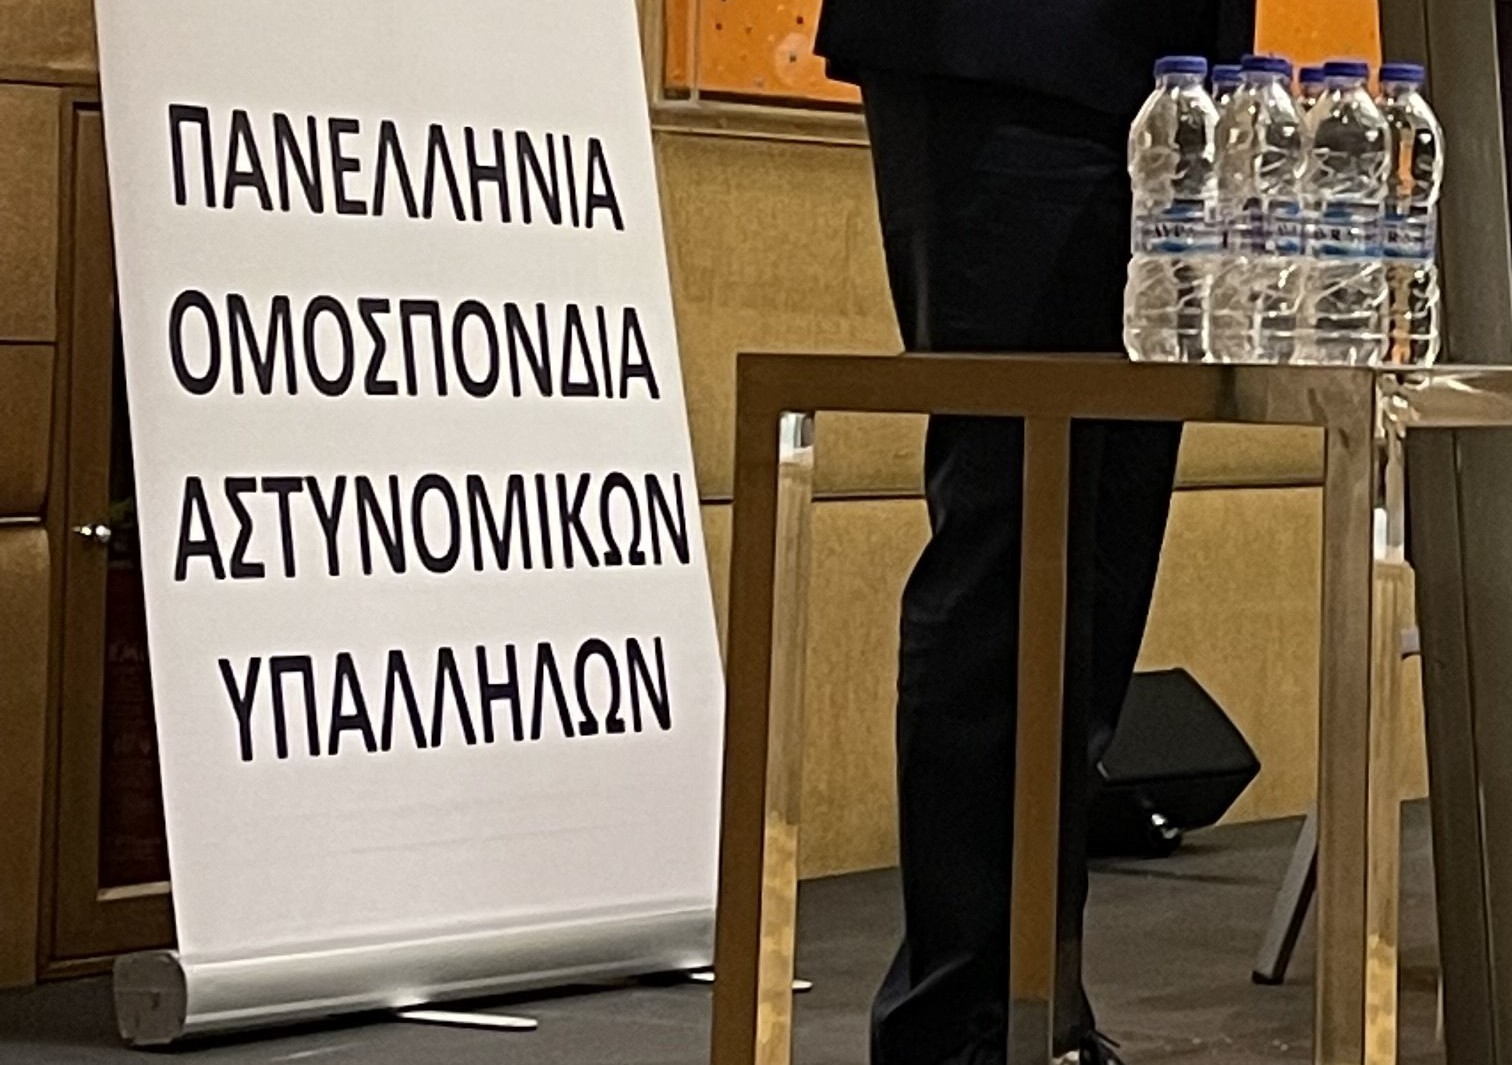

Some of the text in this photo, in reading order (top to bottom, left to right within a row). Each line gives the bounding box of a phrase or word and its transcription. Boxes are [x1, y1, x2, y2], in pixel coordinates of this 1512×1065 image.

[168, 103, 625, 231] ΠΑΝΕΛΛΗΝΙΑ
[168, 289, 660, 400] ΟΜΟΣΠΟΝΔΙΑ
[174, 472, 691, 582] ΑΣΤΥΝΟΜΙΚΩΝ
[218, 636, 672, 762] ΥΠΑΛΛΗΛΩΝ
